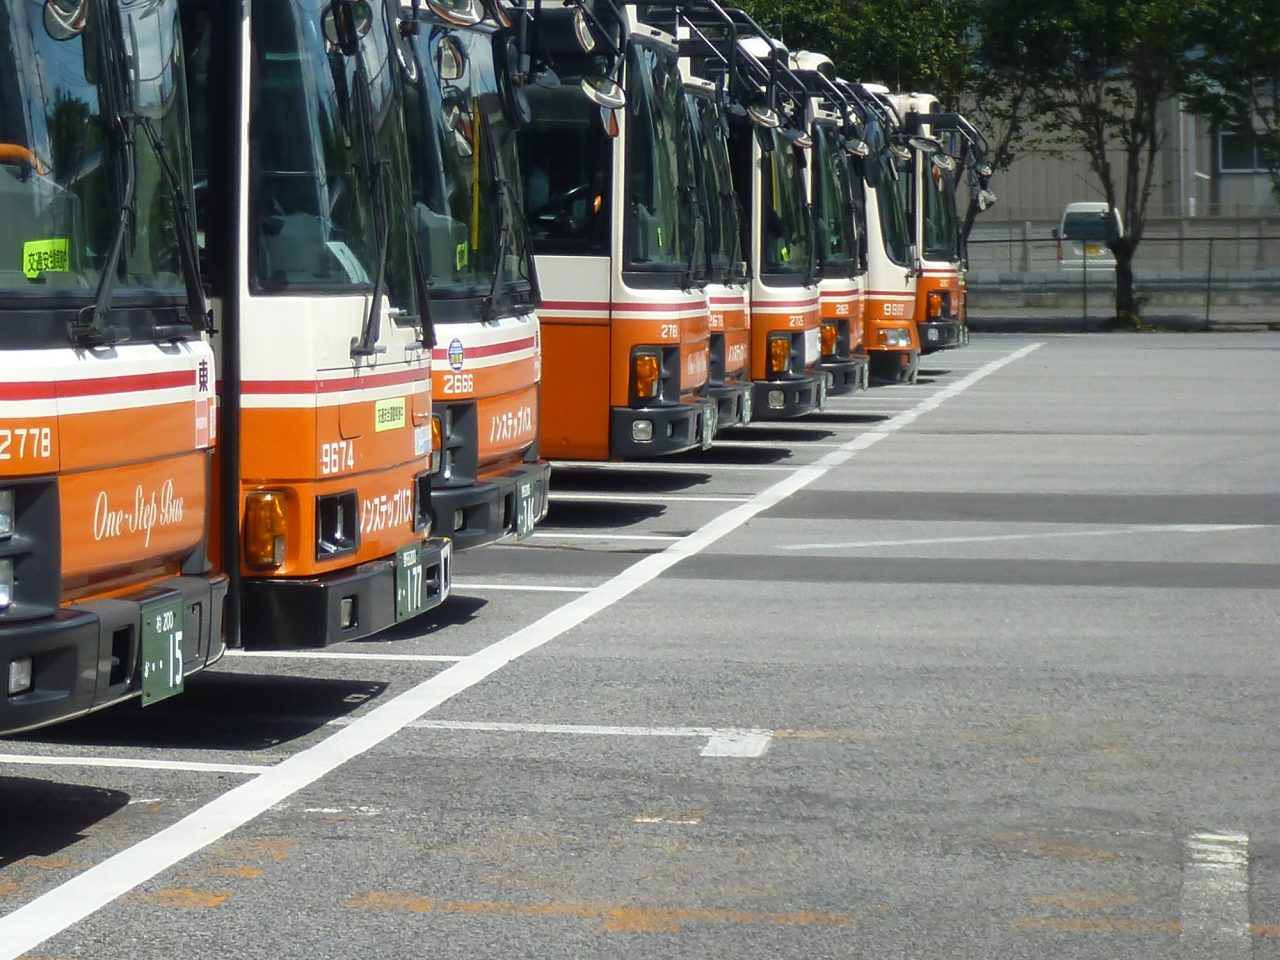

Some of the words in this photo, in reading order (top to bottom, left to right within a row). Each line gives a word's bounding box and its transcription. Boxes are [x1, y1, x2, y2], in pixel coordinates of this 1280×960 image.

[322, 440, 355, 474] 9674
[160, 478, 184, 526] Bus
[360, 488, 412, 534] ノンステップバス
[170, 630, 183, 687] 15
